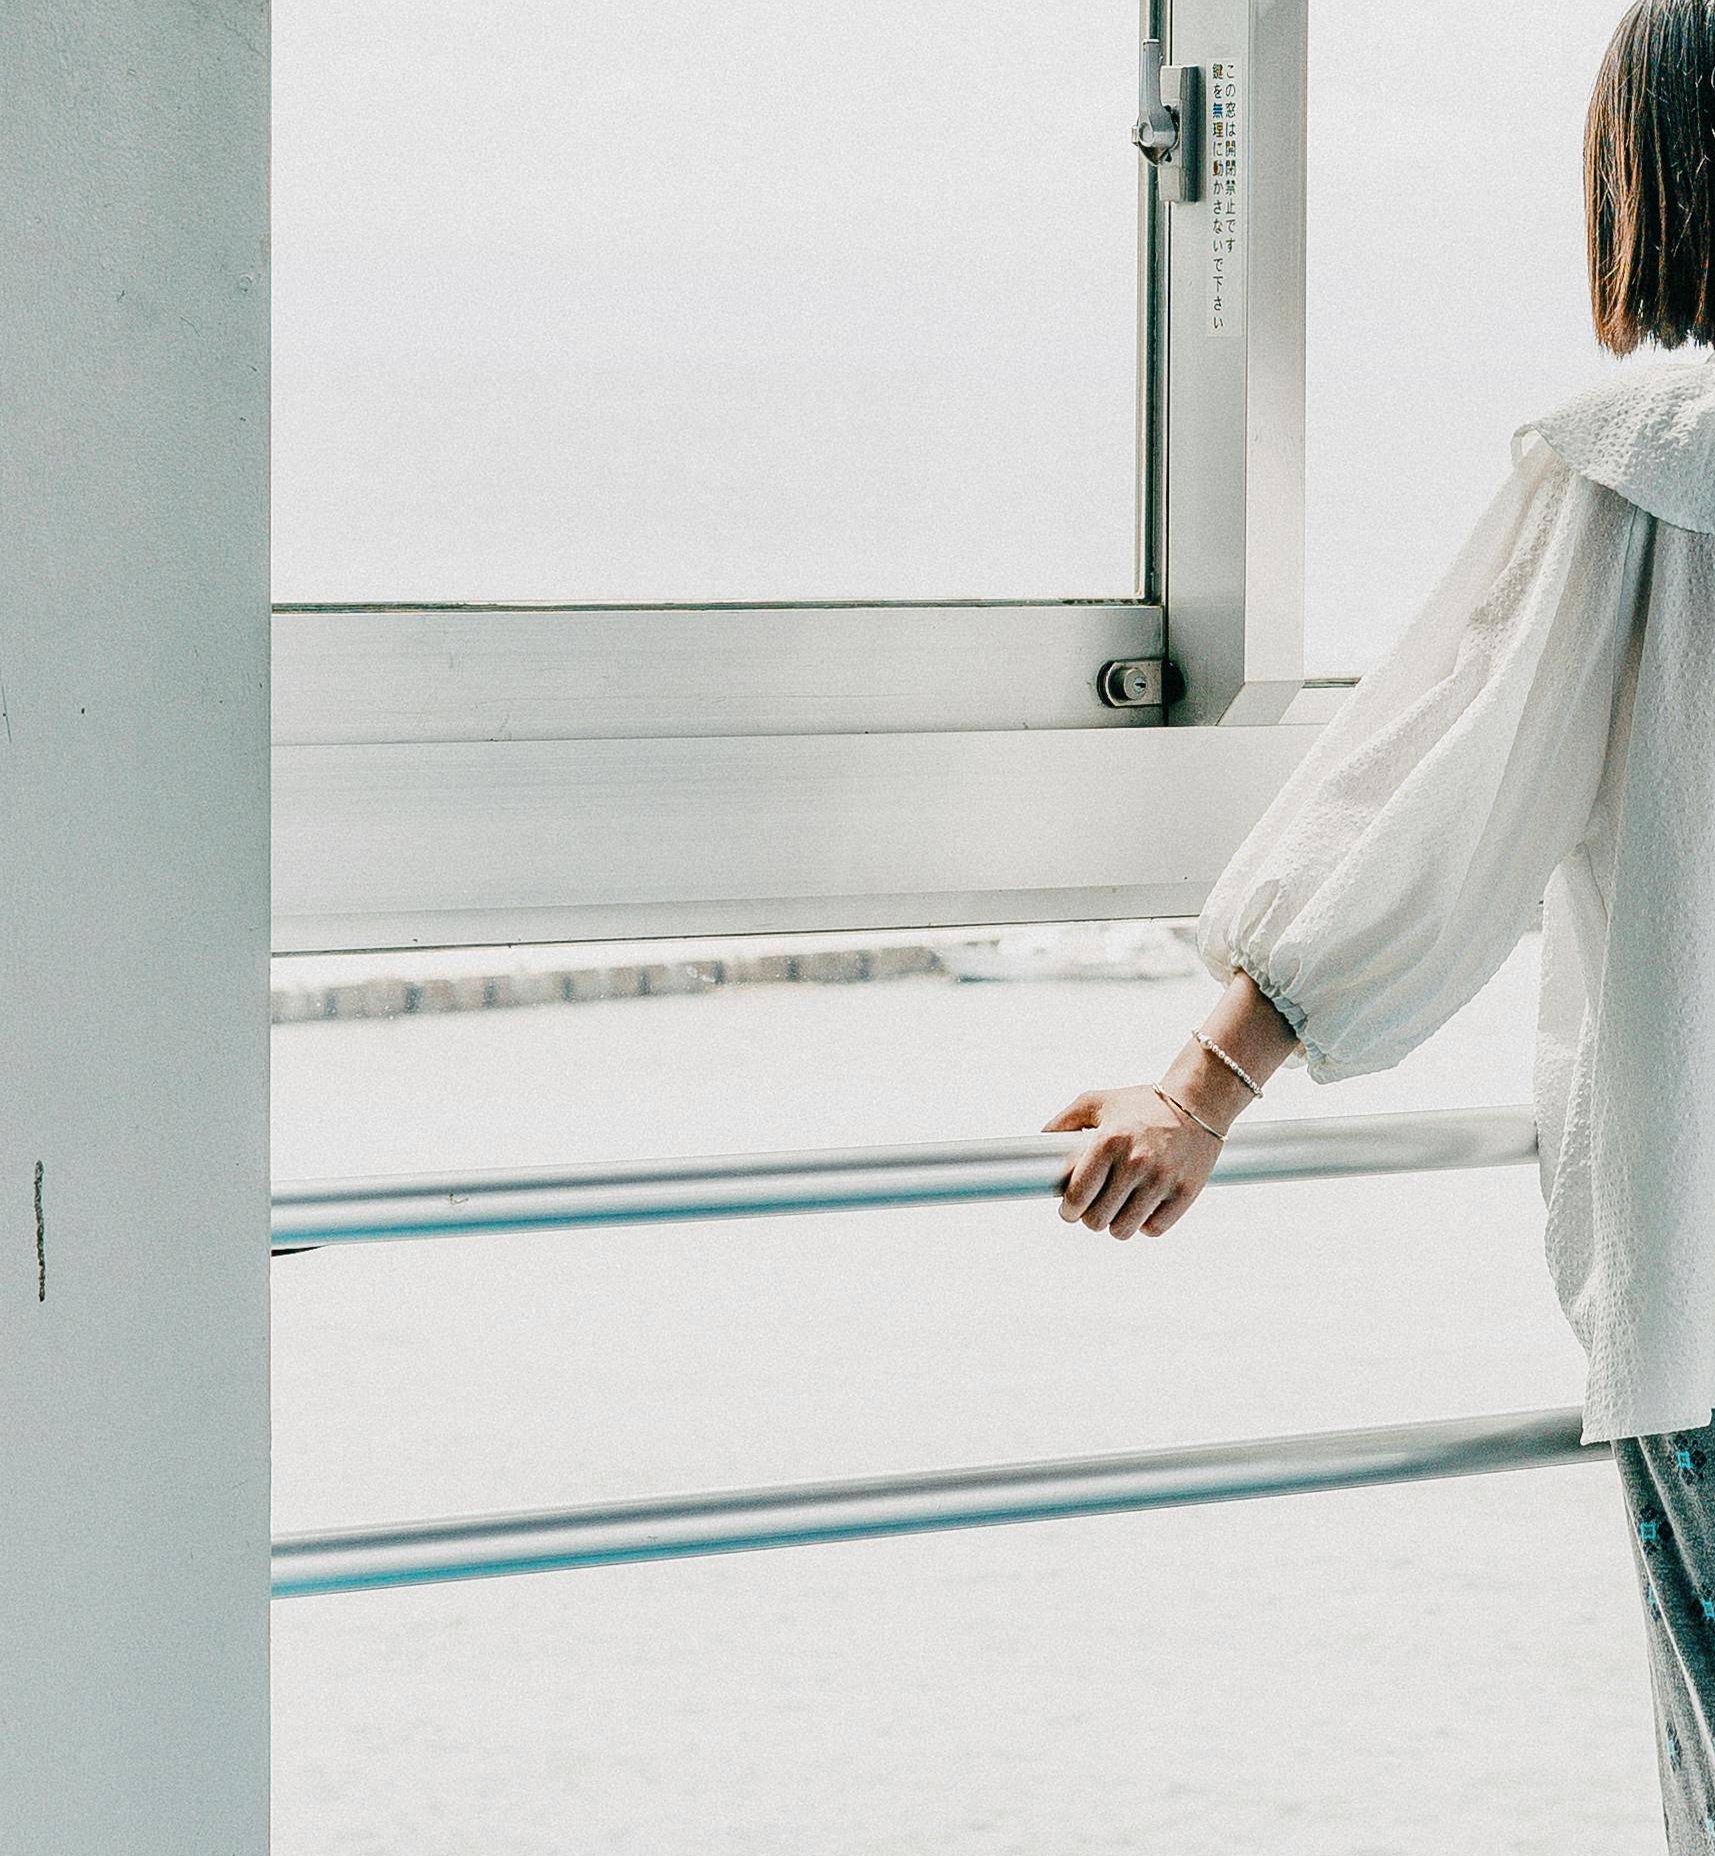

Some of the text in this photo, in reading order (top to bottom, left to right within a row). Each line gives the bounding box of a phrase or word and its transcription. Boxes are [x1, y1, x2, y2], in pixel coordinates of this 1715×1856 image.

[1212, 63, 1224, 329] 鍵を無理に動かさないで下さい
[1225, 64, 1236, 253] この窓は開閉禁止です
